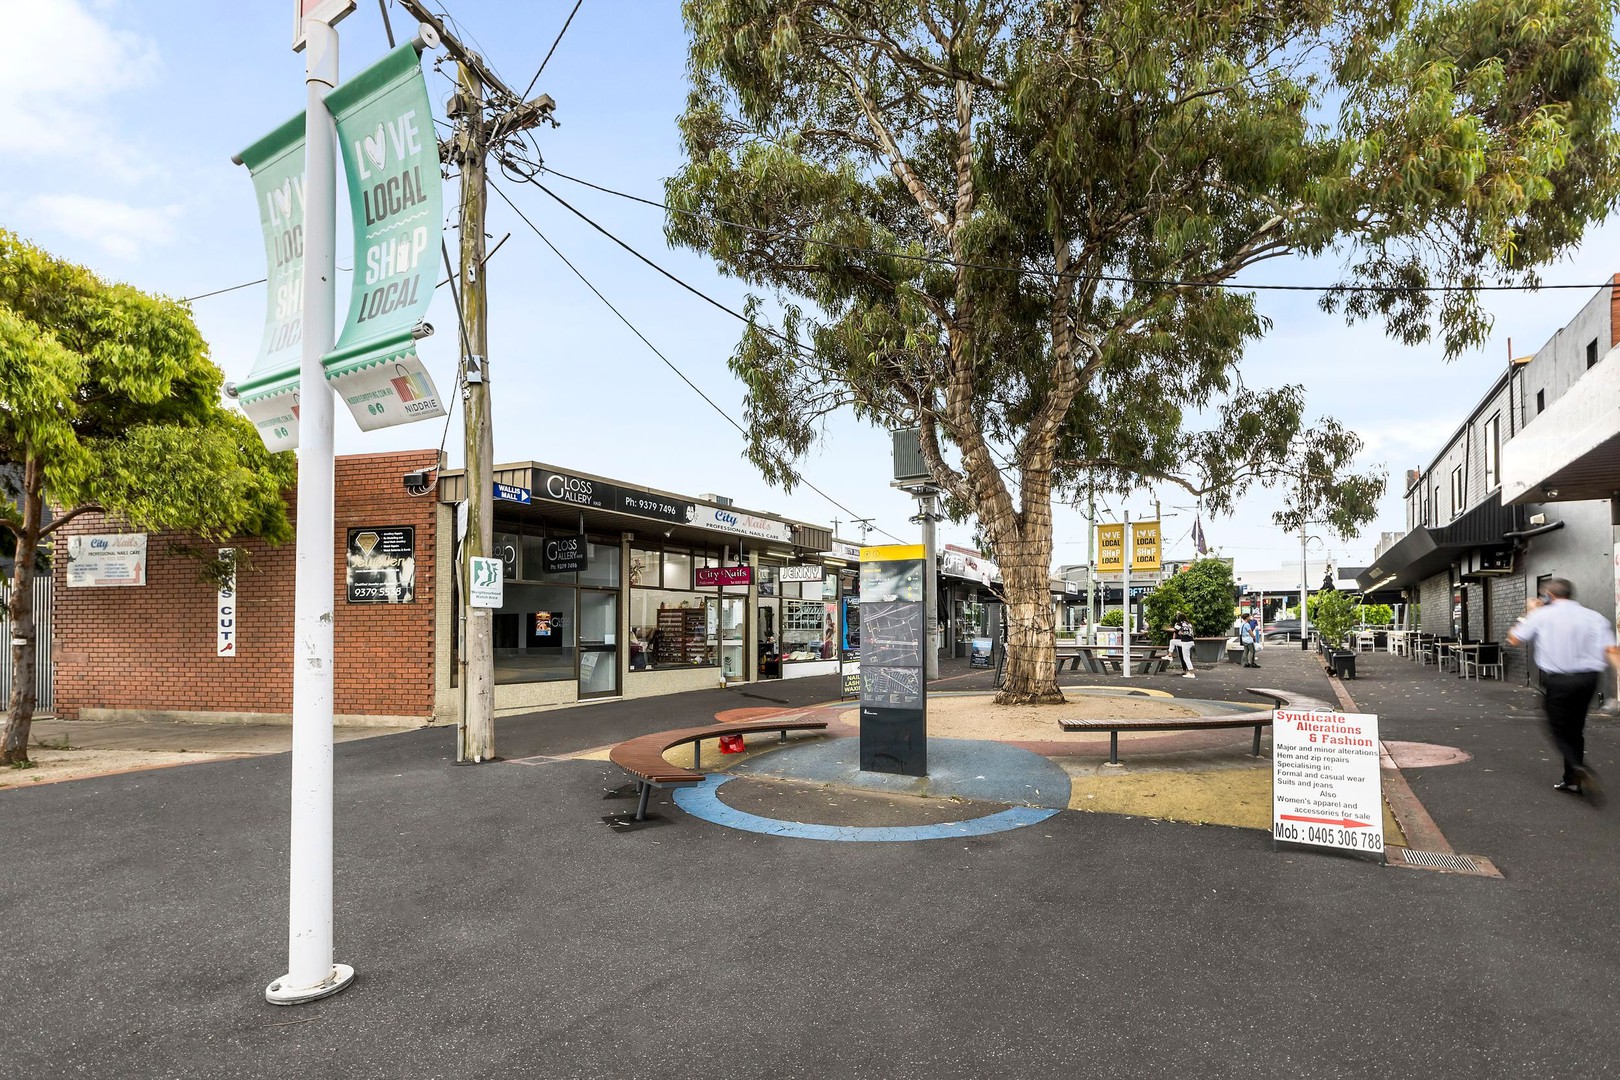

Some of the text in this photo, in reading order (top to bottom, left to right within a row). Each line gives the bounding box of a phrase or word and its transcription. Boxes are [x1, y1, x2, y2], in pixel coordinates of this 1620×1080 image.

[363, 166, 427, 226] LOCAL
[274, 224, 304, 268] LOC
[276, 278, 304, 321] SH
[357, 274, 420, 324] LOCAL
[267, 318, 302, 355] LOC
[404, 399, 437, 413] NIDDRIE
[499, 484, 521, 495] WALLIS
[501, 491, 517, 500] MALL
[625, 497, 676, 515] Ph: 9379 7496
[715, 510, 771, 530] City Nails
[706, 522, 748, 535] PROFESSIONAL
[749, 530, 765, 538] NAILS
[91, 537, 138, 550] City Nails
[1102, 539, 1120, 547] LOCAL
[1137, 538, 1156, 546] LOCAL
[1137, 555, 1156, 563] LOCAL
[699, 569, 747, 580] City Nails
[783, 566, 819, 579] JENNY
[354, 587, 401, 597] 9379 5538
[221, 606, 232, 640] CUT
[1277, 711, 1345, 724] Syndicate
[1297, 722, 1361, 734] Alterations
[1309, 733, 1373, 747] & Fashion
[1277, 743, 1296, 752] Major
[1338, 748, 1379, 756] alterations
[1311, 755, 1321, 763] zip
[1277, 761, 1333, 771] Specialising in:
[1277, 769, 1302, 777] Formal
[1304, 771, 1318, 779] and
[1320, 773, 1344, 781] casual
[1277, 778, 1295, 786] Suits
[1313, 781, 1333, 789] jeans
[1320, 790, 1337, 798] Also
[1277, 795, 1311, 805] Women's
[1313, 799, 1340, 808] apparel
[1294, 807, 1370, 820] accessories for sale
[1276, 822, 1298, 840] Mob
[1308, 826, 1334, 844] 0405
[1337, 829, 1357, 847] 306
[1361, 832, 1381, 850] 788
